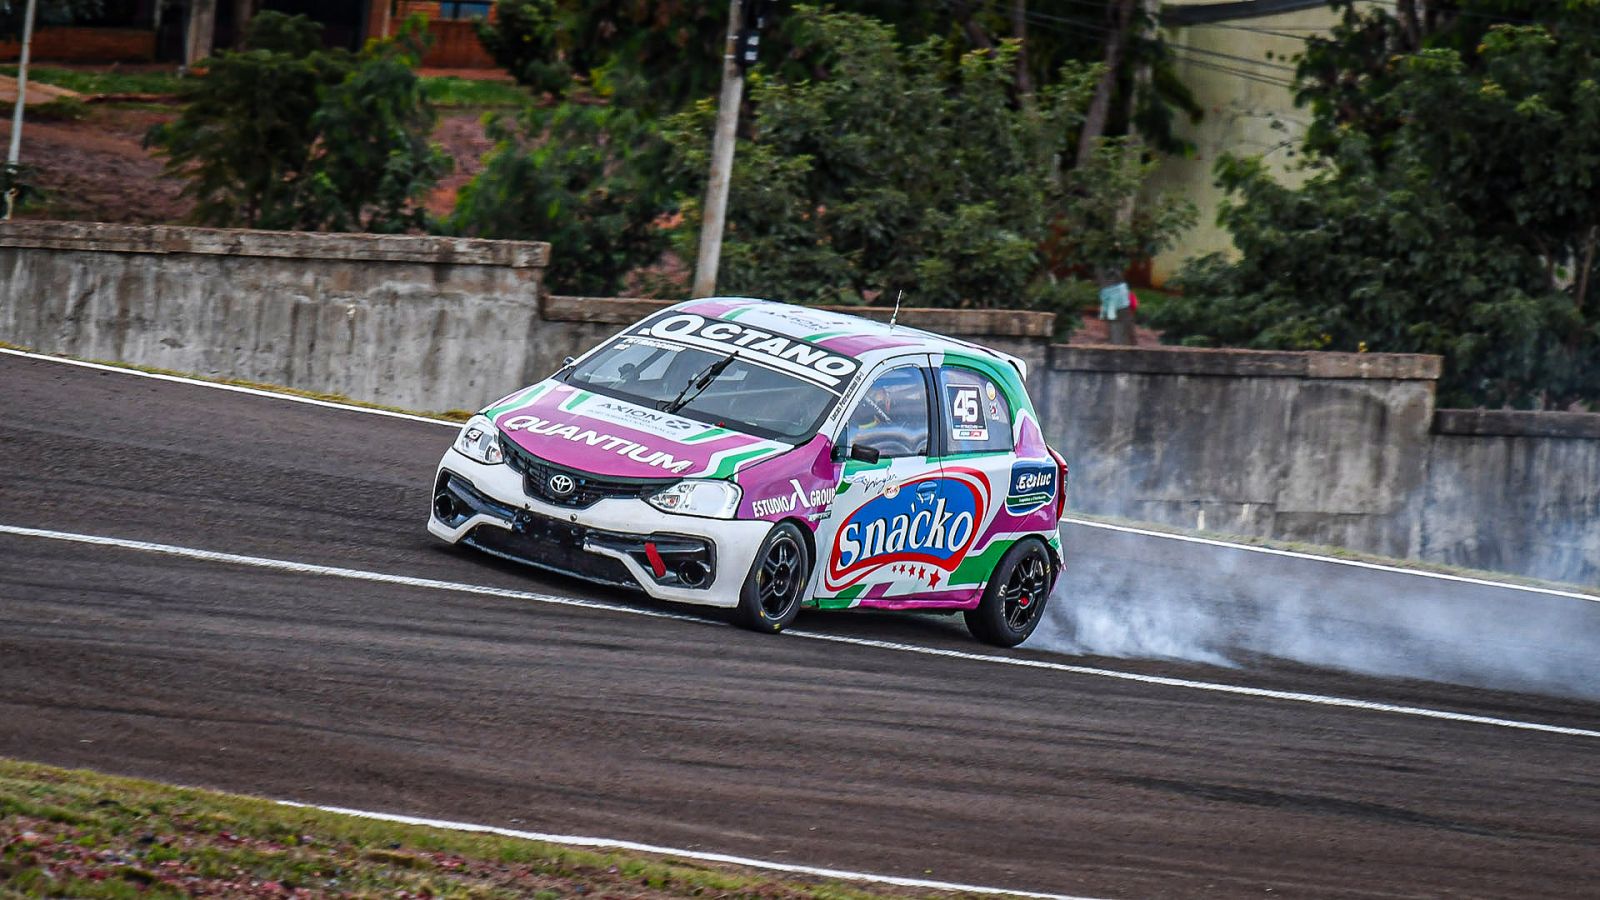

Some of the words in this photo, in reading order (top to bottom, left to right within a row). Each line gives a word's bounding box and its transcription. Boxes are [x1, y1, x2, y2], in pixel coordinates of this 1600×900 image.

[596, 402, 662, 422] AXION
[953, 389, 978, 422] 45
[503, 415, 693, 474] QUANTIUM
[752, 495, 790, 518] ESTUDIO
[810, 487, 837, 507] GROUP
